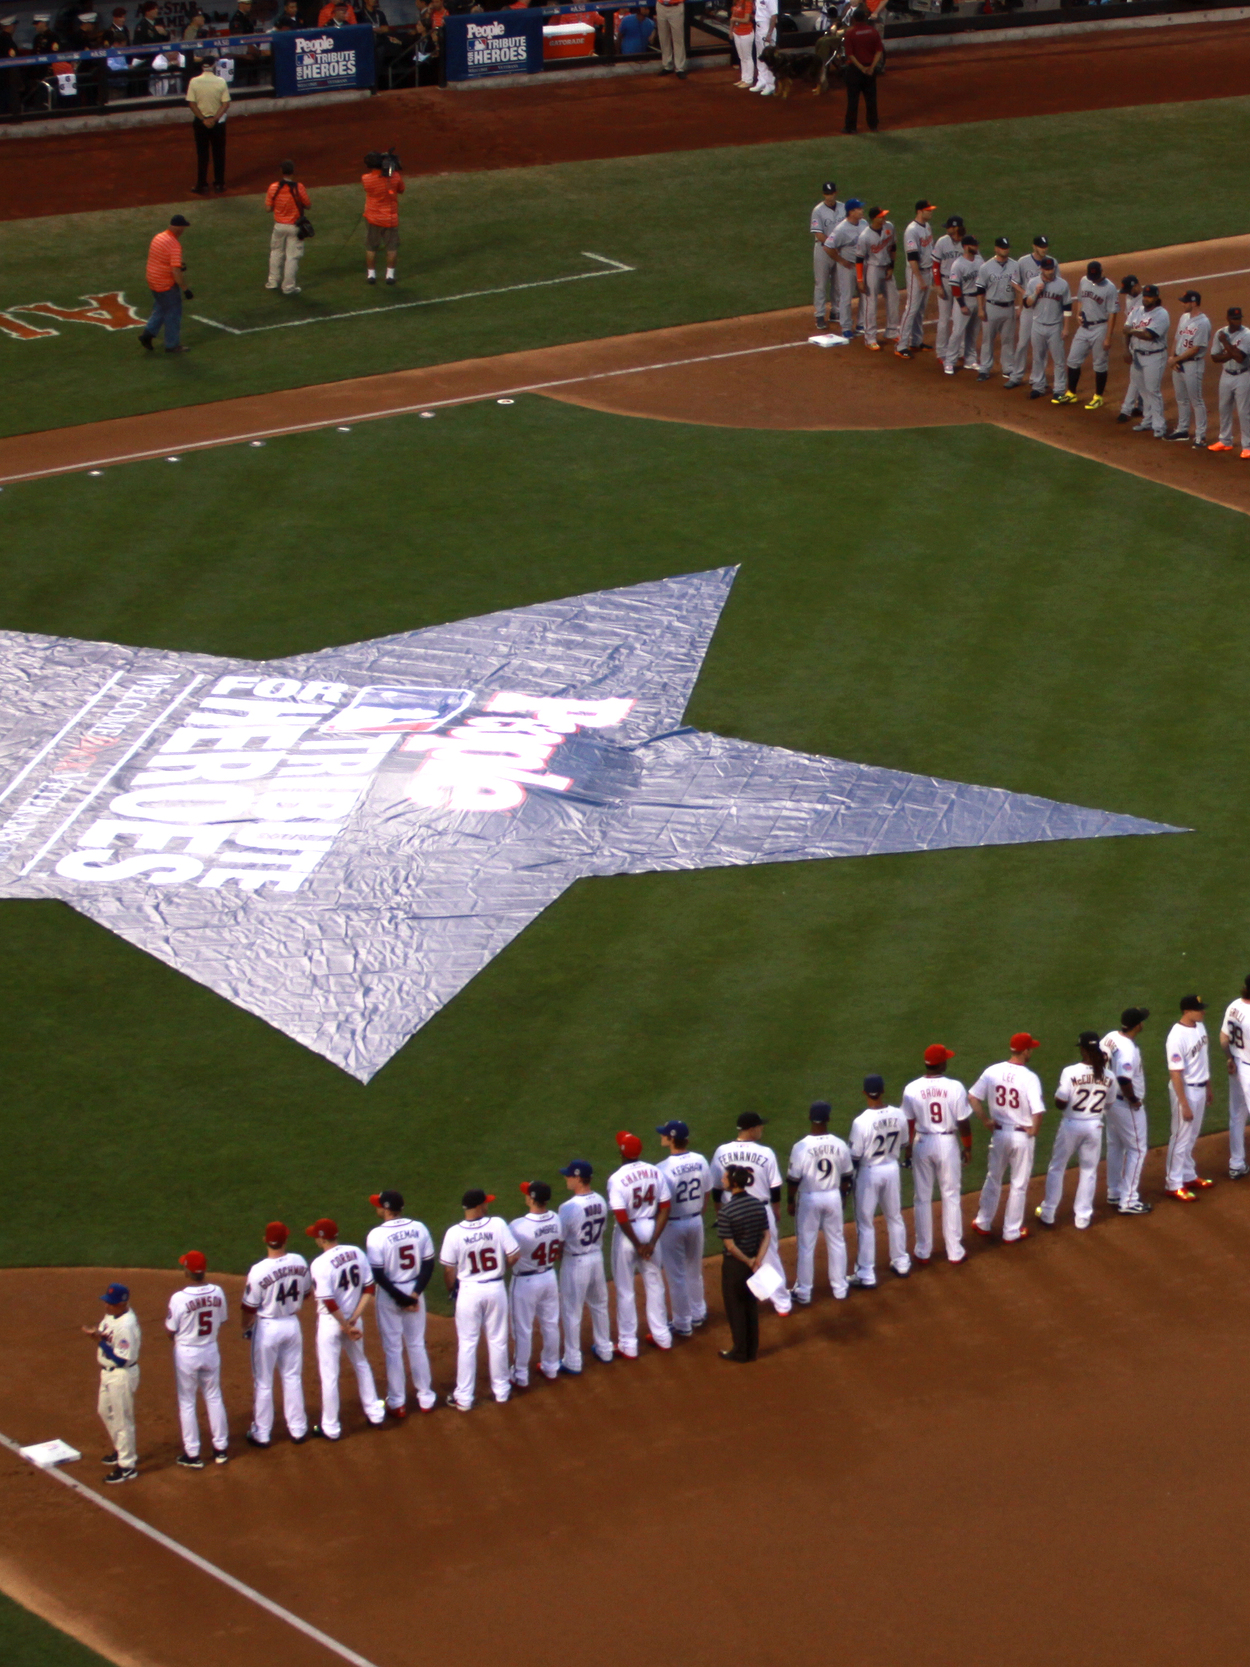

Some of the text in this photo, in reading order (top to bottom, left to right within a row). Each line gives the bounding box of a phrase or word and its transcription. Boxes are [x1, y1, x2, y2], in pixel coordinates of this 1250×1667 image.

[466, 21, 505, 39] People
[295, 35, 334, 53] People
[487, 35, 526, 49] TRIBUTE
[549, 38, 585, 46] GATORADE
[316, 50, 356, 64] TRIBUTE
[474, 46, 527, 64] HEROES
[303, 60, 356, 79] HEROES
[210, 675, 350, 704] FOR
[55, 696, 336, 884] HEROES
[1229, 1007, 1245, 1024] GRILLI
[1227, 1020, 1245, 1049] 39
[1002, 1072, 1016, 1084] LEE
[920, 1087, 948, 1100] BROWN
[995, 1085, 1020, 1109] 33
[1072, 1088, 1107, 1113] 22
[930, 1101, 943, 1124] 9
[872, 1117, 898, 1131] GOMEZ
[871, 1130, 900, 1158] 27
[620, 1168, 659, 1188] CHAPMAN
[671, 1162, 703, 1177] KERSHAW
[817, 1158, 833, 1181] 9
[632, 1183, 656, 1211] 54
[675, 1177, 701, 1204] 22
[583, 1203, 602, 1218] WOOD
[387, 1229, 420, 1244] FREEMAN
[463, 1231, 493, 1245] McCANN
[579, 1217, 605, 1247] 37
[330, 1250, 358, 1269] CORBIN
[398, 1244, 416, 1270] 5
[467, 1247, 498, 1275] 16
[531, 1239, 560, 1267] 46
[338, 1264, 360, 1292] 46
[276, 1278, 299, 1306] 44
[185, 1295, 223, 1315] JOHNSON
[198, 1310, 213, 1337] 5
